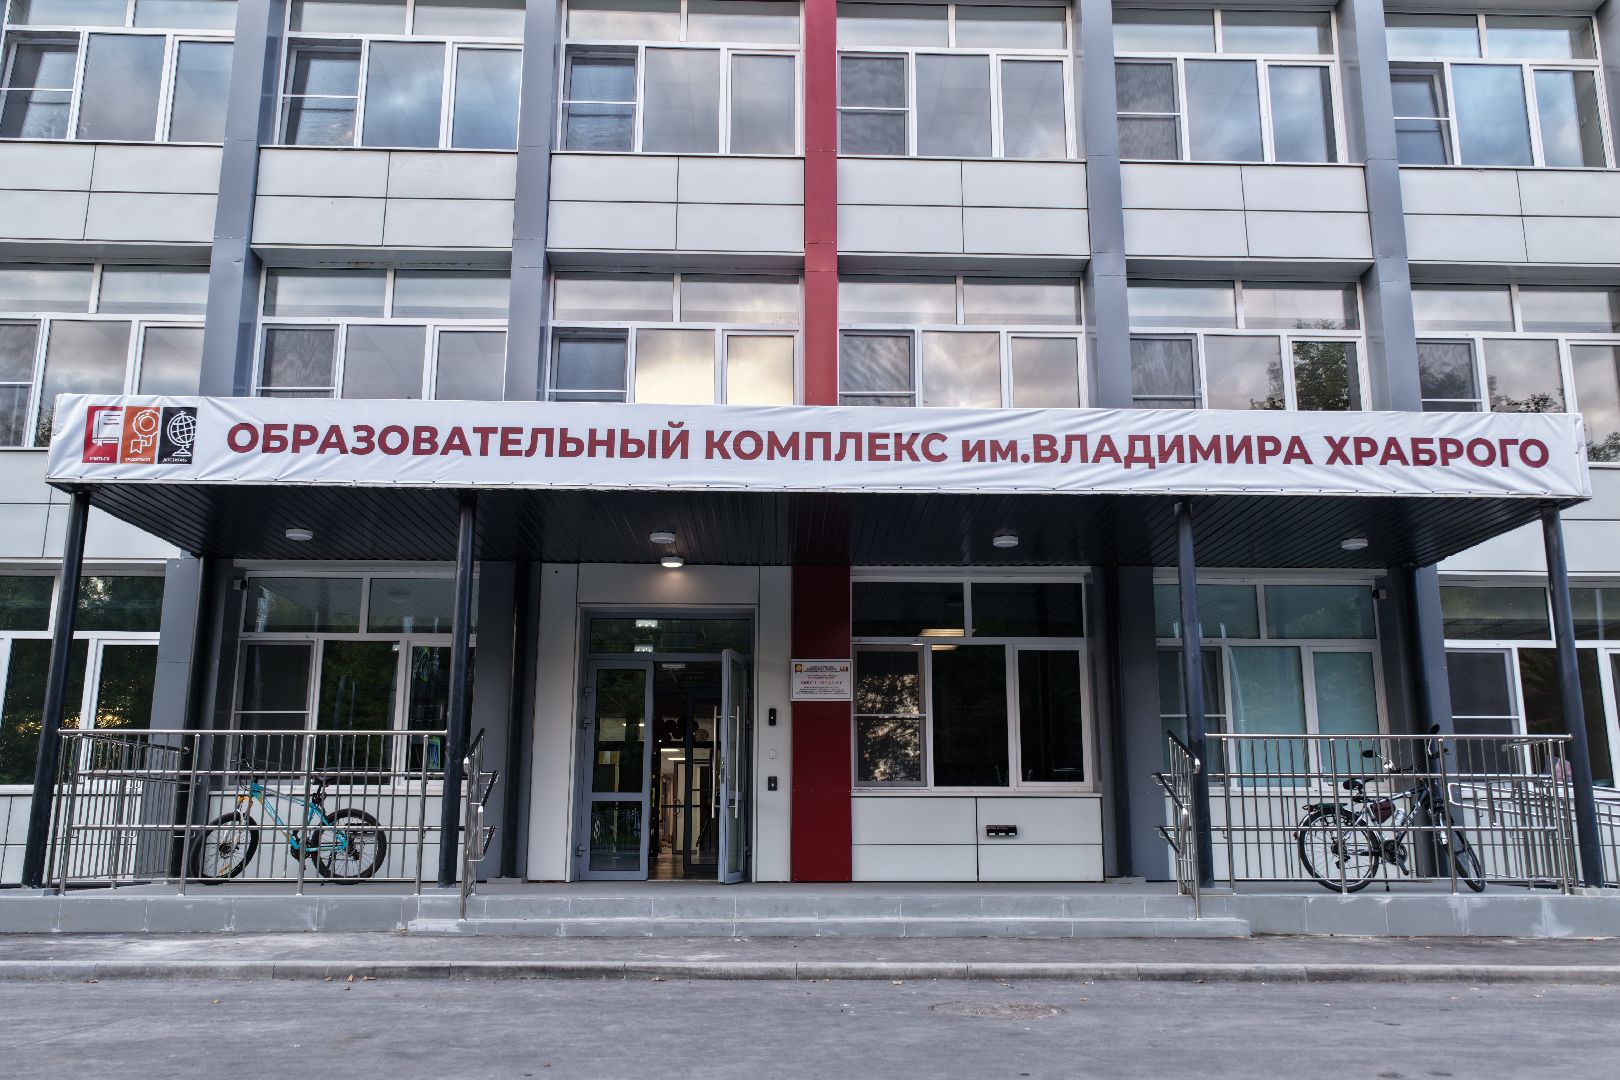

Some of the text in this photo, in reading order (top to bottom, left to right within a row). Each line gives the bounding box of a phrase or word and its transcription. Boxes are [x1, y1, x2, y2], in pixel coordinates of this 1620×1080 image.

[228, 420, 690, 460] ОБРАЗОВАТЕЛЬНЫЙ
[705, 430, 948, 463] КОМПЛЕКС
[1323, 435, 1550, 469] ХРАБРОГО
